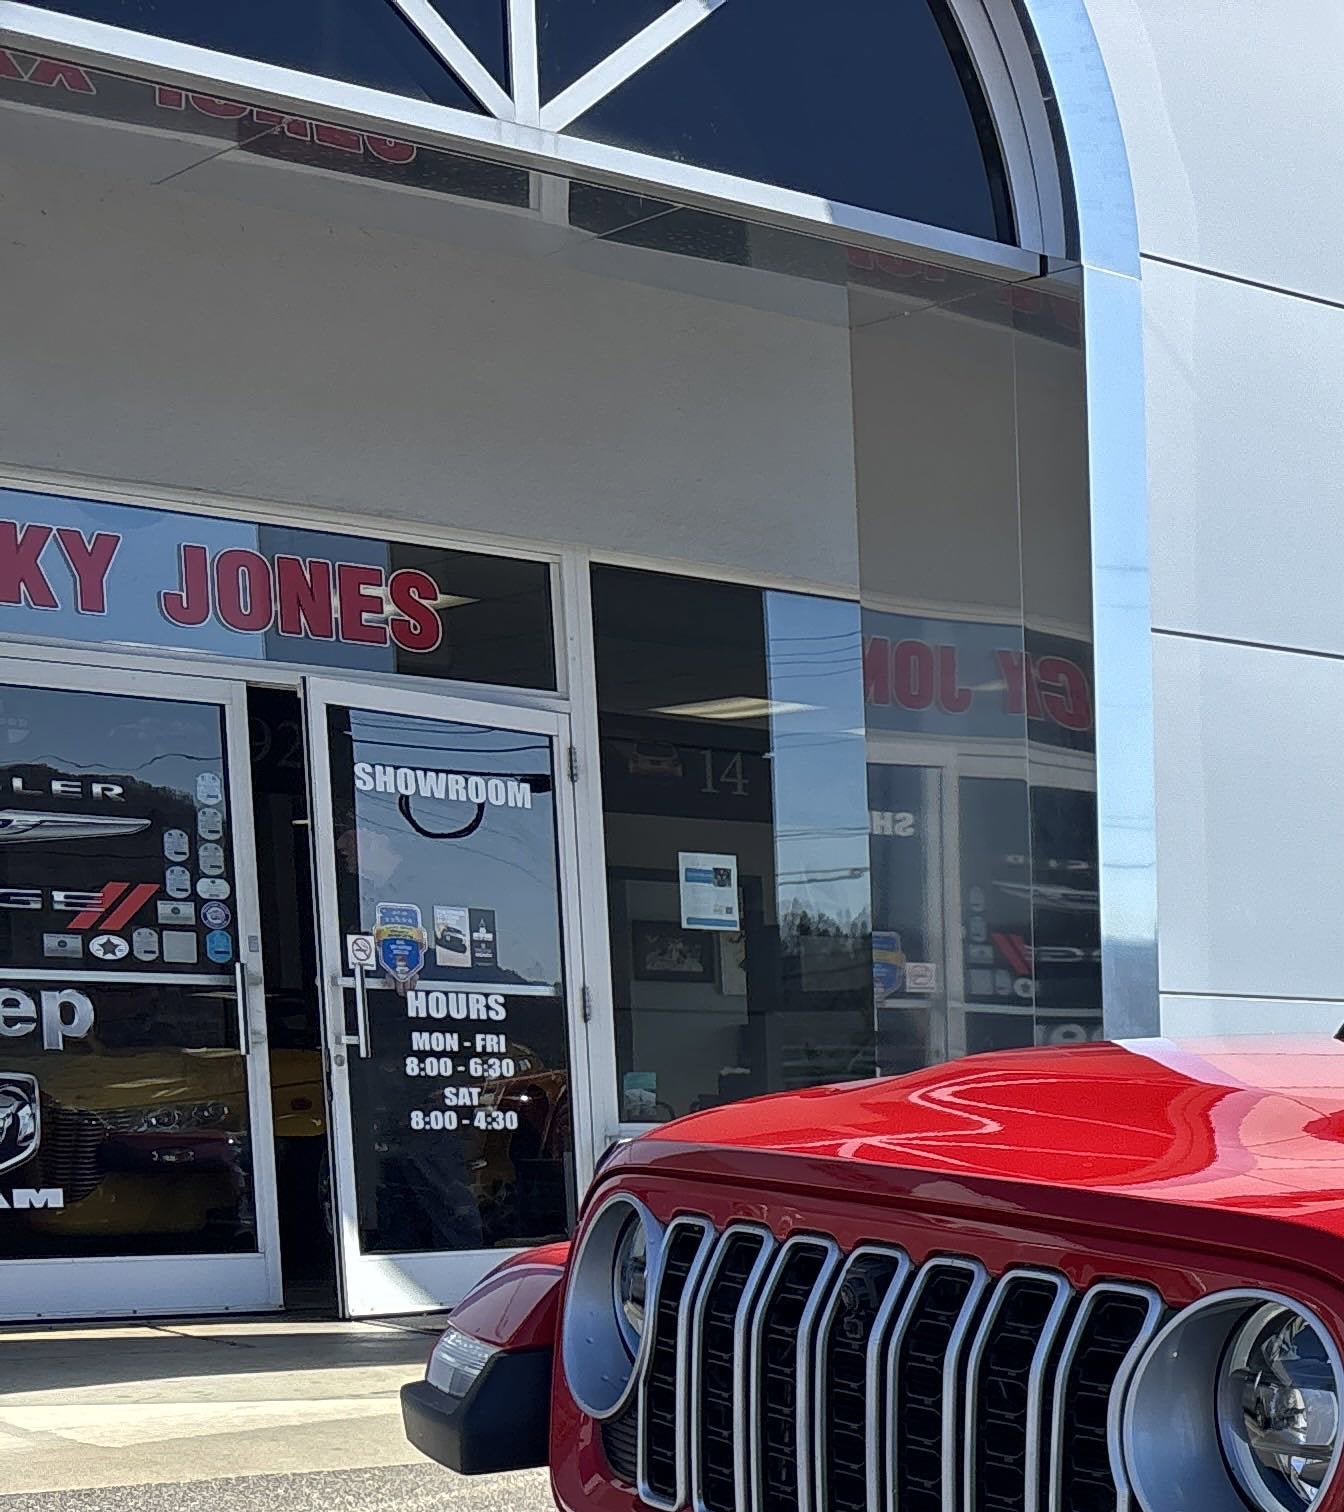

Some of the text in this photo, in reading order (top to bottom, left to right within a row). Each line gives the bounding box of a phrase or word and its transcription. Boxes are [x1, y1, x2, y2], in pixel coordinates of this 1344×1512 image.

[160, 543, 442, 652] JONES
[699, 749, 750, 796] 14
[354, 762, 532, 809] SHOWROOM
[407, 991, 507, 1020] HOURS
[411, 1032, 459, 1051] MON
[475, 1034, 506, 1053] FRI
[405, 1057, 453, 1077] 8:00
[469, 1058, 515, 1077] 6:30
[443, 1086, 481, 1106] SAT
[410, 1111, 458, 1130] 8:00
[474, 1111, 518, 1130] 4:30
